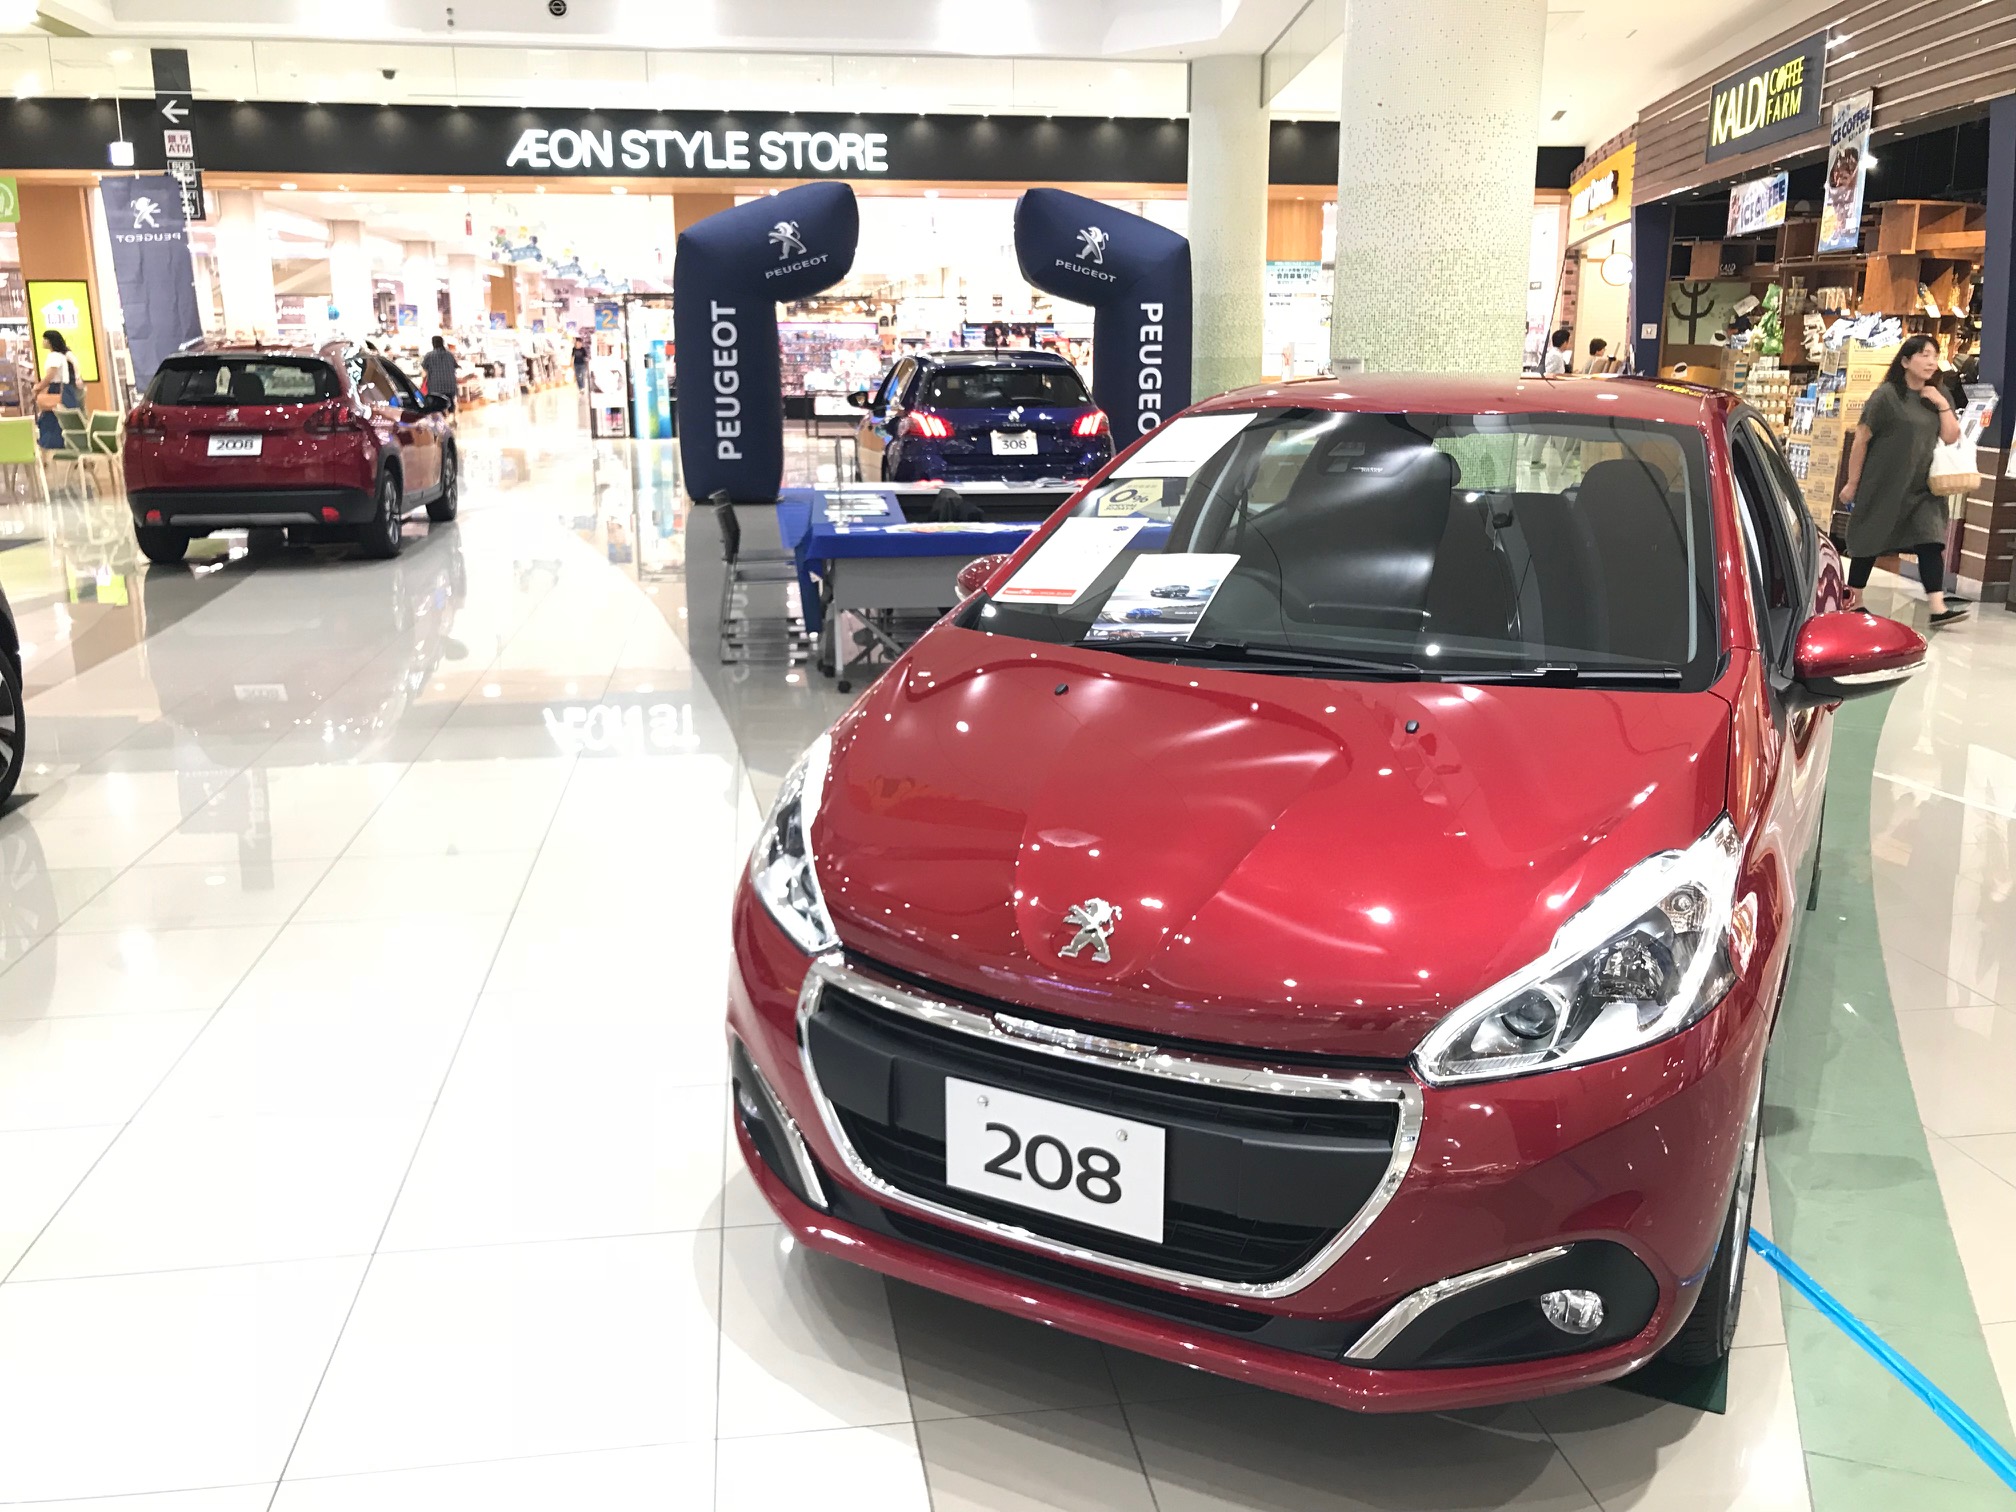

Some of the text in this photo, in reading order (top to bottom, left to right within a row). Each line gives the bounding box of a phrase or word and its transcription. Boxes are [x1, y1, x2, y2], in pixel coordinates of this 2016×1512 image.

[1769, 56, 1805, 95] COFFEE
[1712, 71, 1770, 147] KALDI
[1766, 86, 1803, 126] FARM
[168, 143, 192, 154] ATM
[621, 129, 750, 171] STYLE
[759, 131, 889, 172] STORE
[765, 254, 828, 280] PEUGEOT
[1055, 258, 1117, 283] PEUGEOT
[710, 300, 743, 460] PEUGEOT
[1137, 302, 1164, 435] PEUGEO
[216, 439, 254, 451] 2008
[1002, 440, 1027, 450] 308
[983, 1121, 1122, 1205] 208
